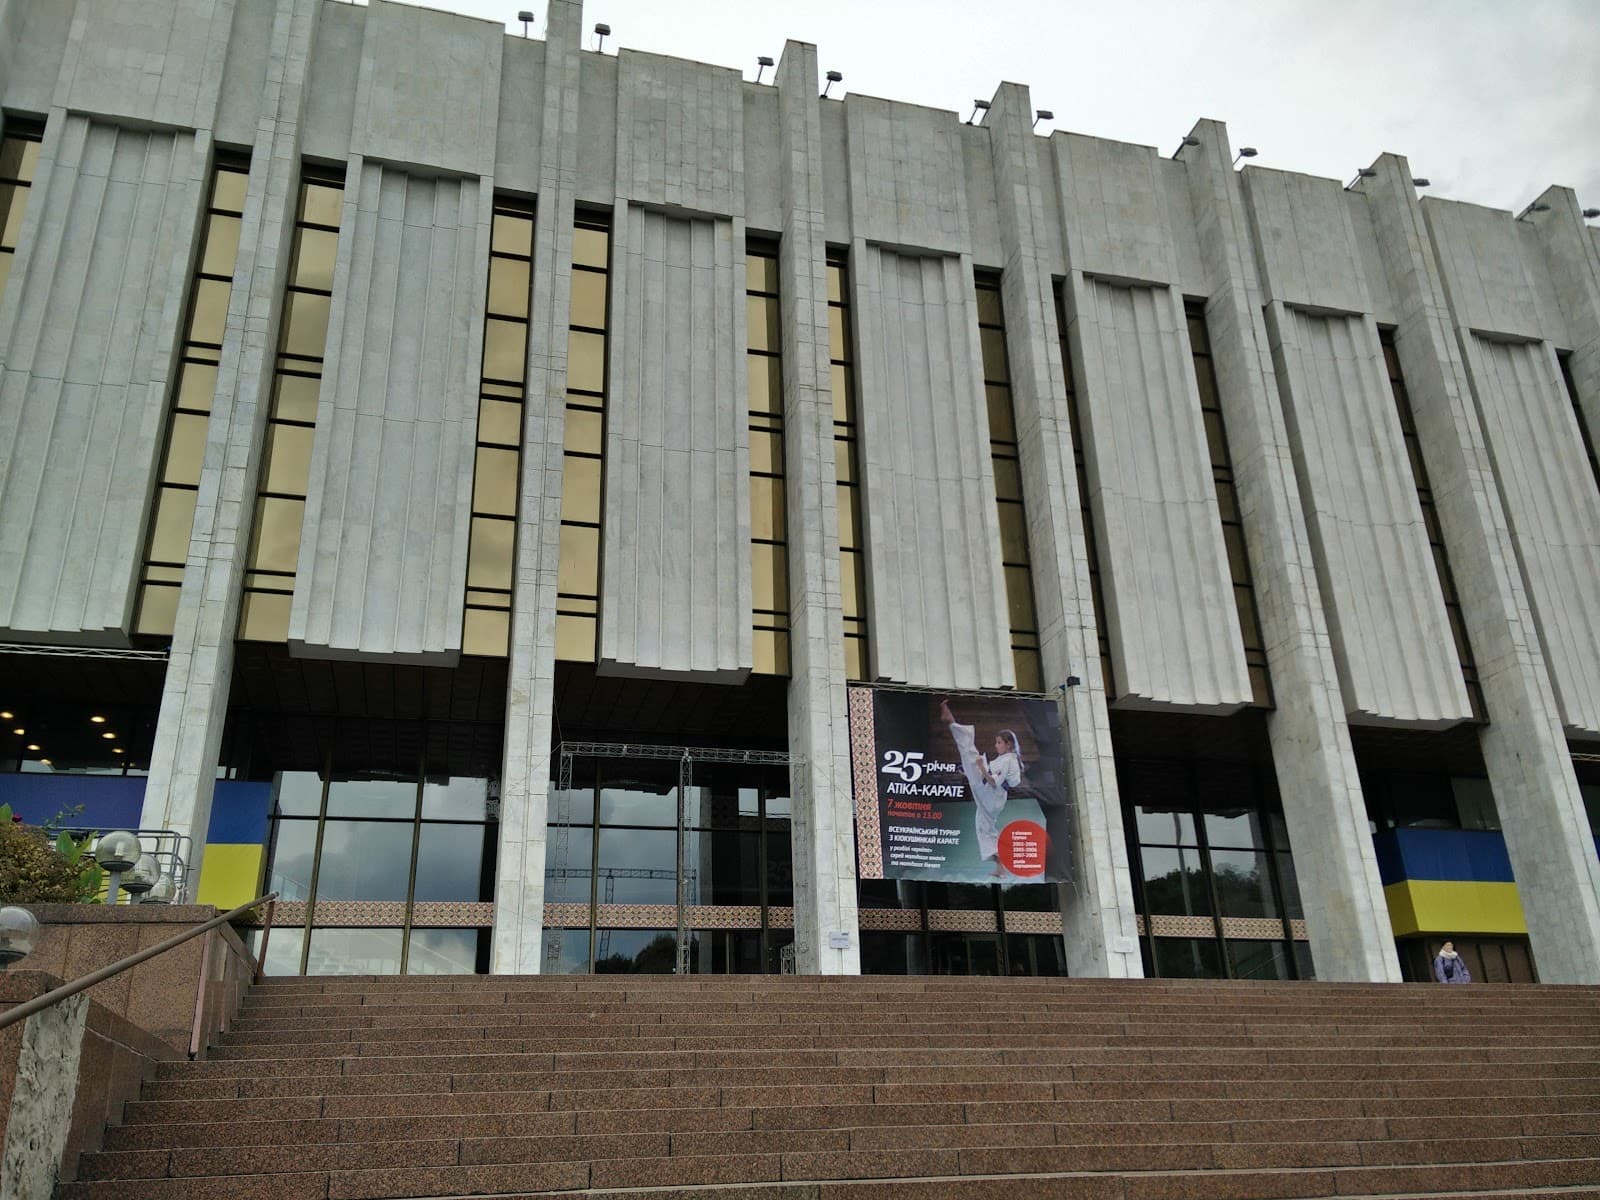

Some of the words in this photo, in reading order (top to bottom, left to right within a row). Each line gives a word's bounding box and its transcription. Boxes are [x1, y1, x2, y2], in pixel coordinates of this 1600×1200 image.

[881, 750, 957, 782] 25-річчя
[887, 799, 894, 808] 7
[895, 801, 932, 811] жовтня
[939, 829, 961, 837] ТУРНІР
